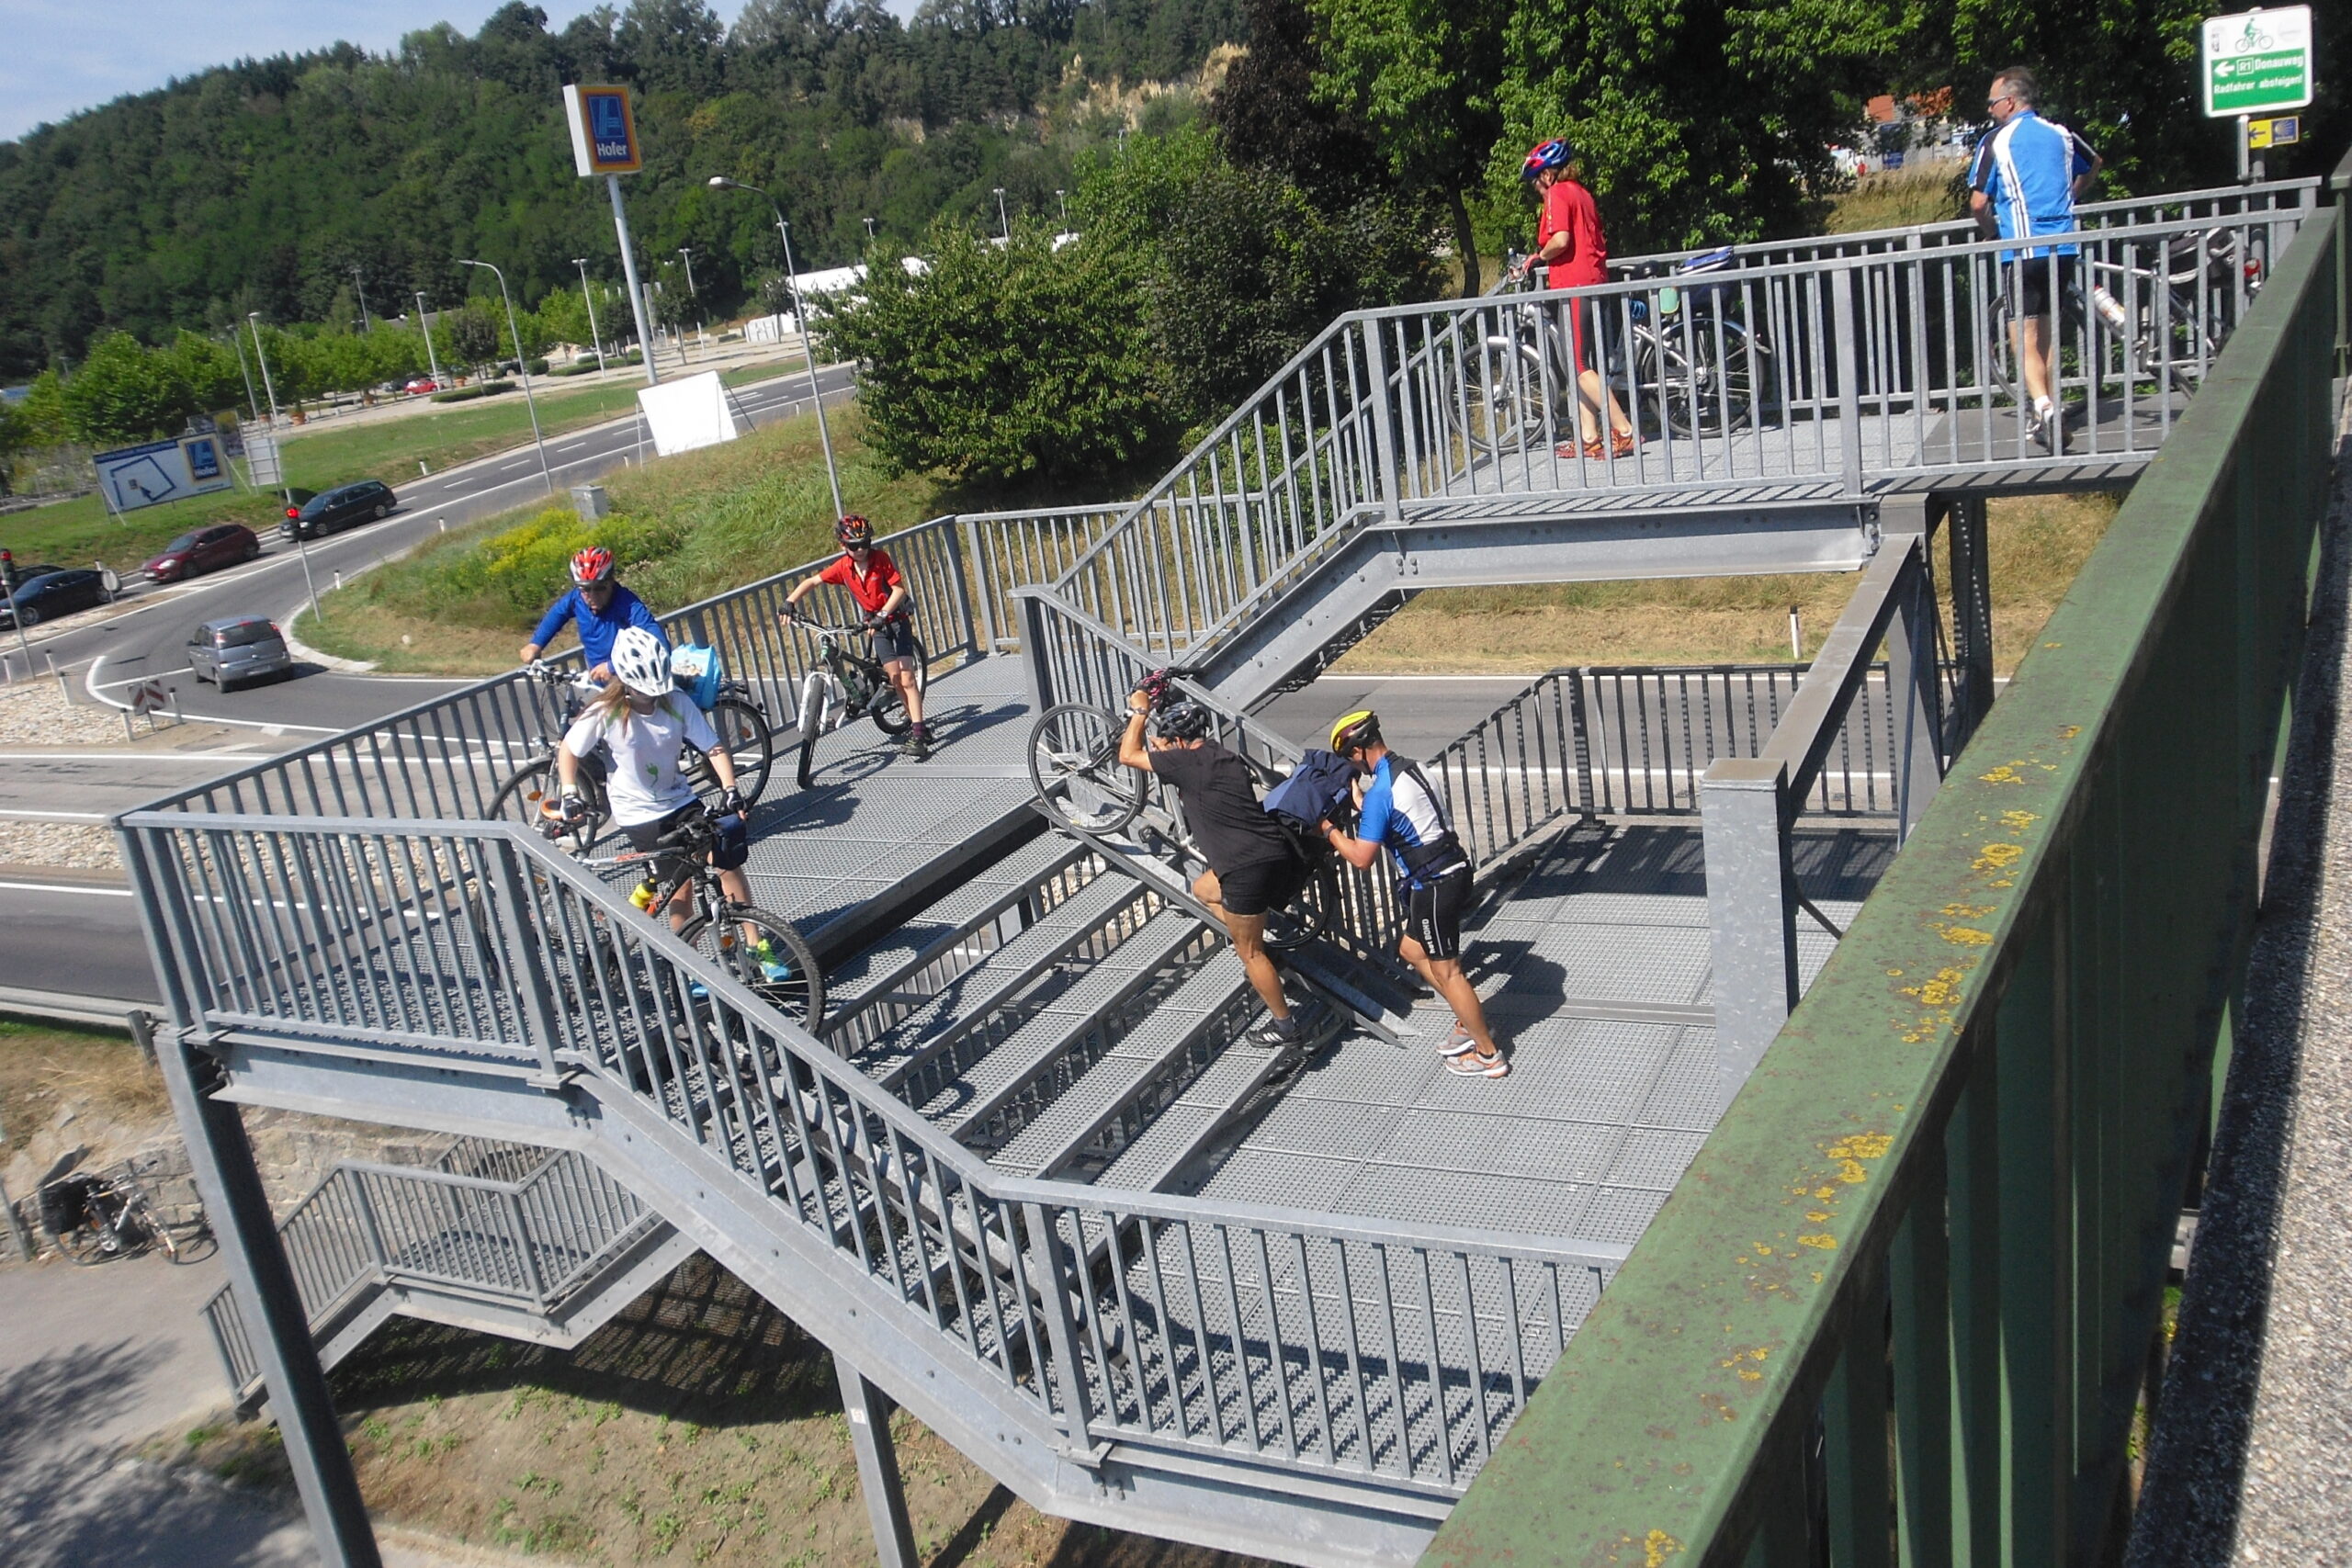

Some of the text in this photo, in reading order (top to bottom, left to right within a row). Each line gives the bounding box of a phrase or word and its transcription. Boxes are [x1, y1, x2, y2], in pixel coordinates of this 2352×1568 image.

[2239, 56, 2303, 72] R1 Donauweg
[2214, 81, 2255, 94] Radfahrer
[597, 141, 627, 156] Hofer
